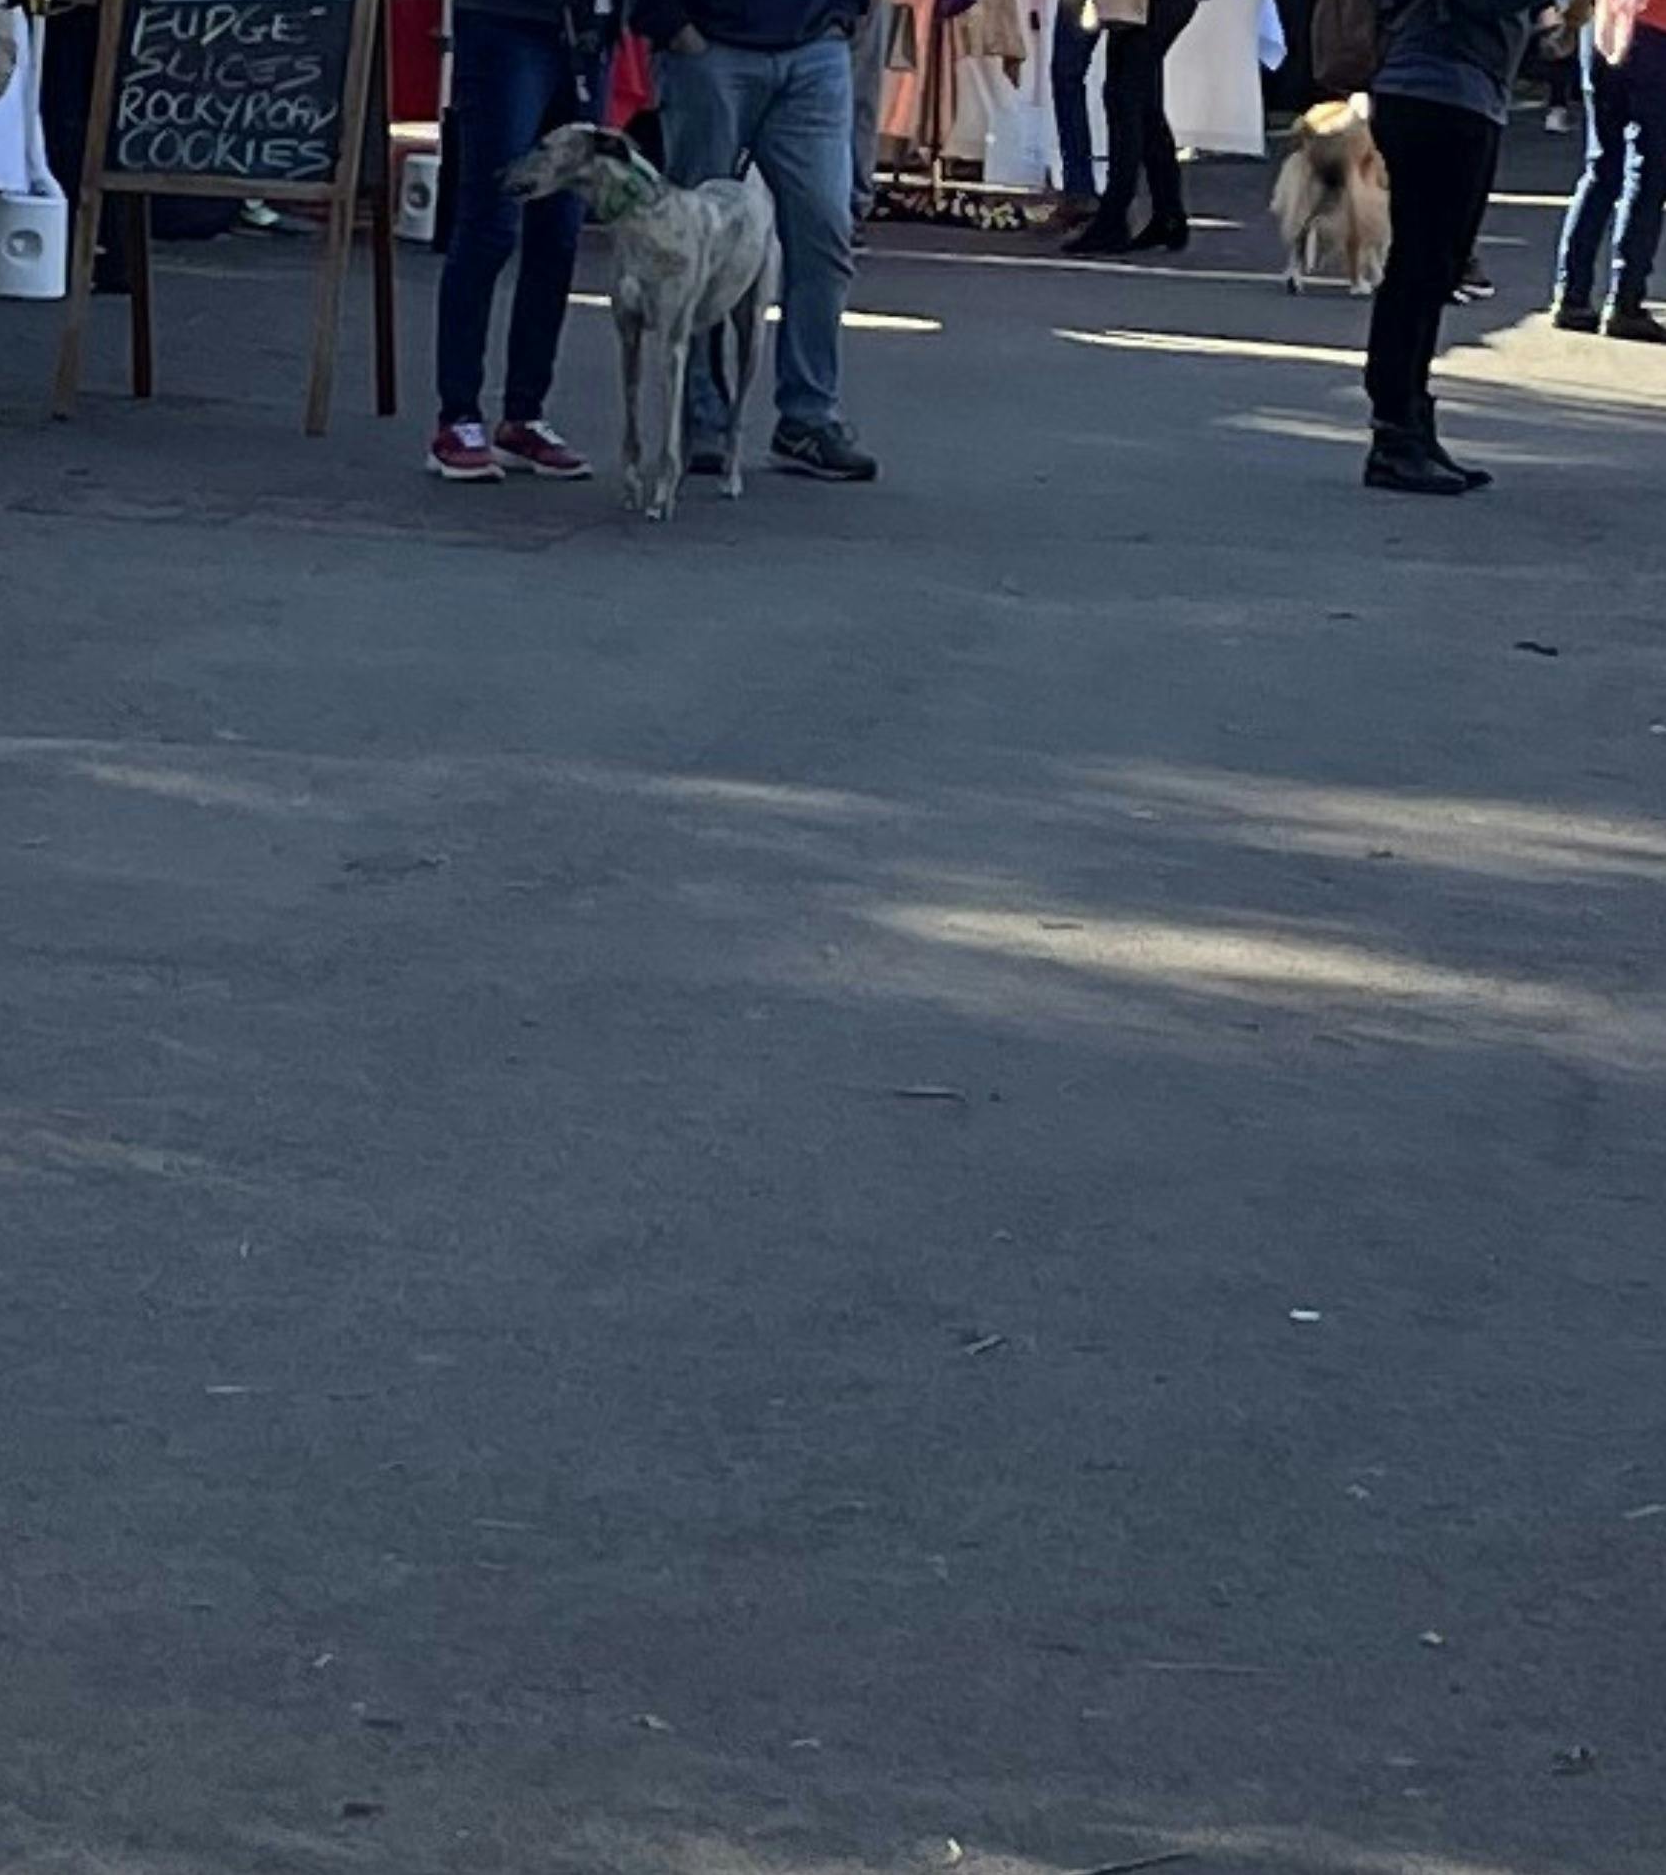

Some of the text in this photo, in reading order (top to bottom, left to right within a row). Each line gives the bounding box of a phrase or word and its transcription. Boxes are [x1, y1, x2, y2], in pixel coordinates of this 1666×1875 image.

[131, 4, 325, 57] FUDGE
[124, 46, 322, 93] SLICES
[118, 127, 331, 180] COOKIES
